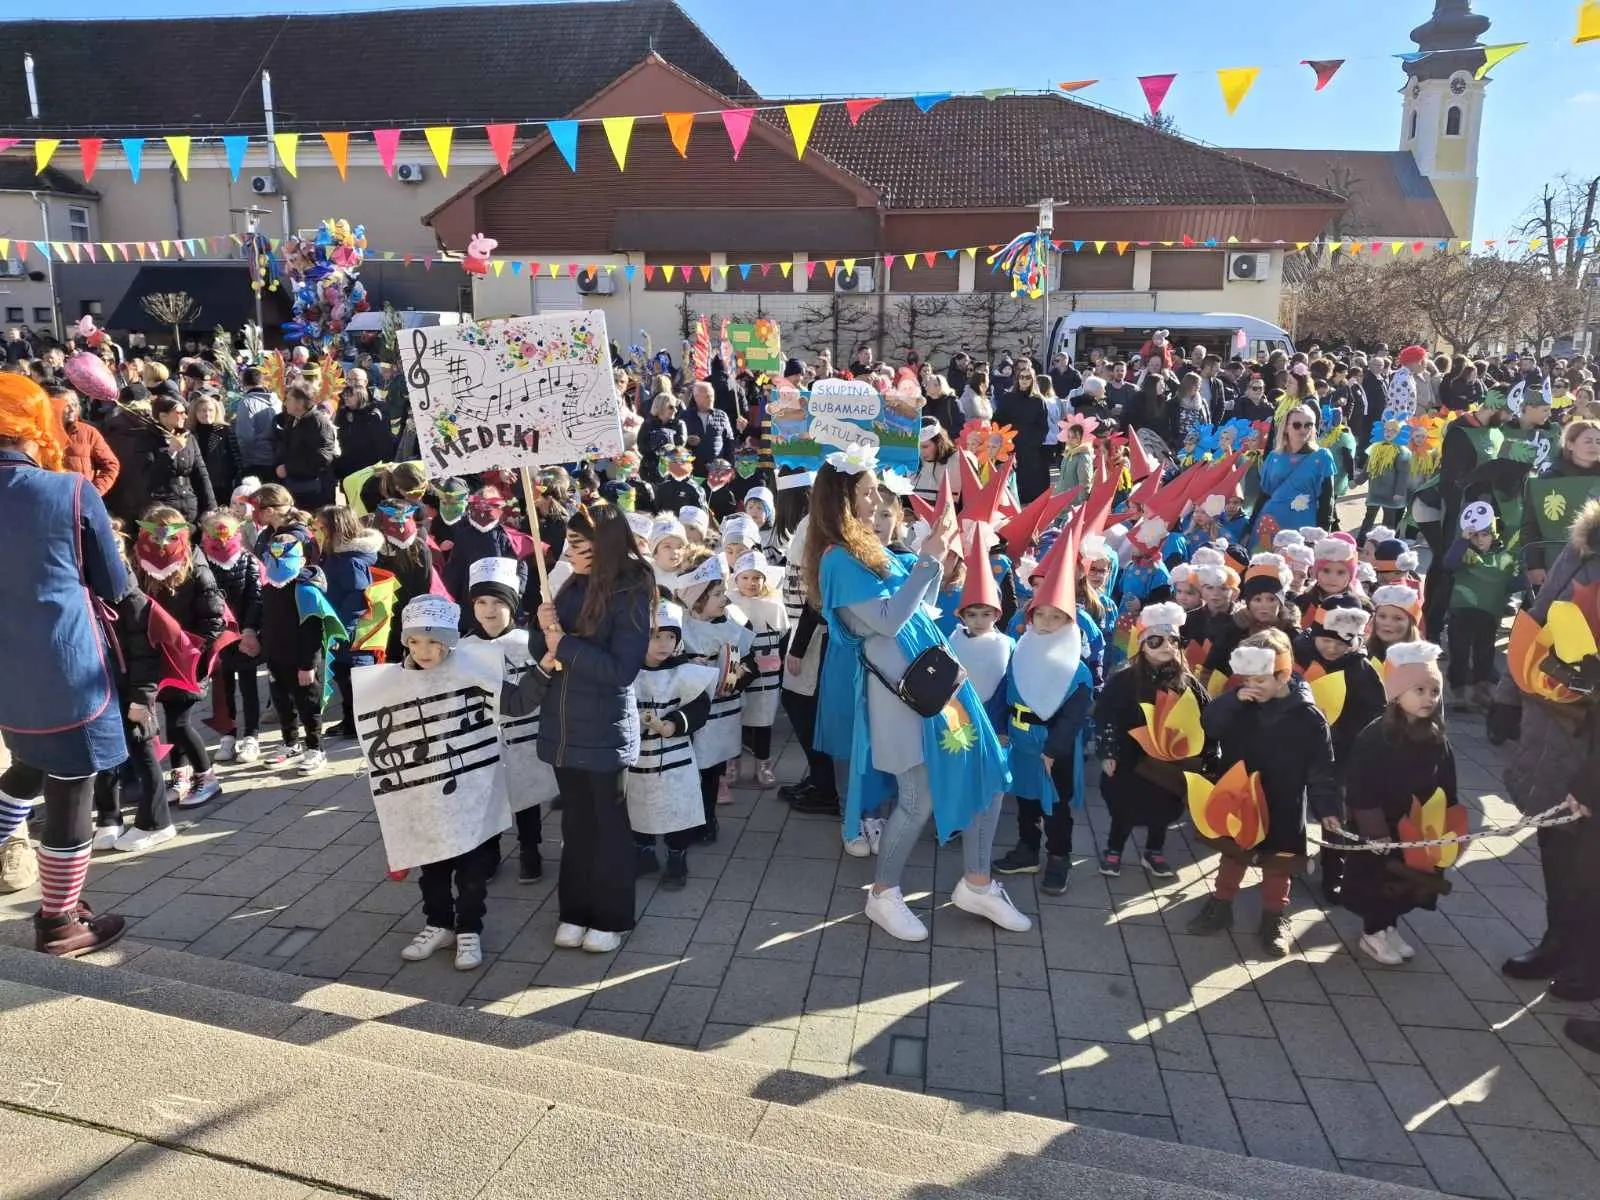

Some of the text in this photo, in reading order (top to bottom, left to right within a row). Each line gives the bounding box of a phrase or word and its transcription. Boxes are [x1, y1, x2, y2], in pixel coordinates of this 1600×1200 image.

[817, 385, 870, 396] SKUPINA
[811, 402, 876, 416] BUBAMARE
[430, 423, 540, 469] MEDEKI
